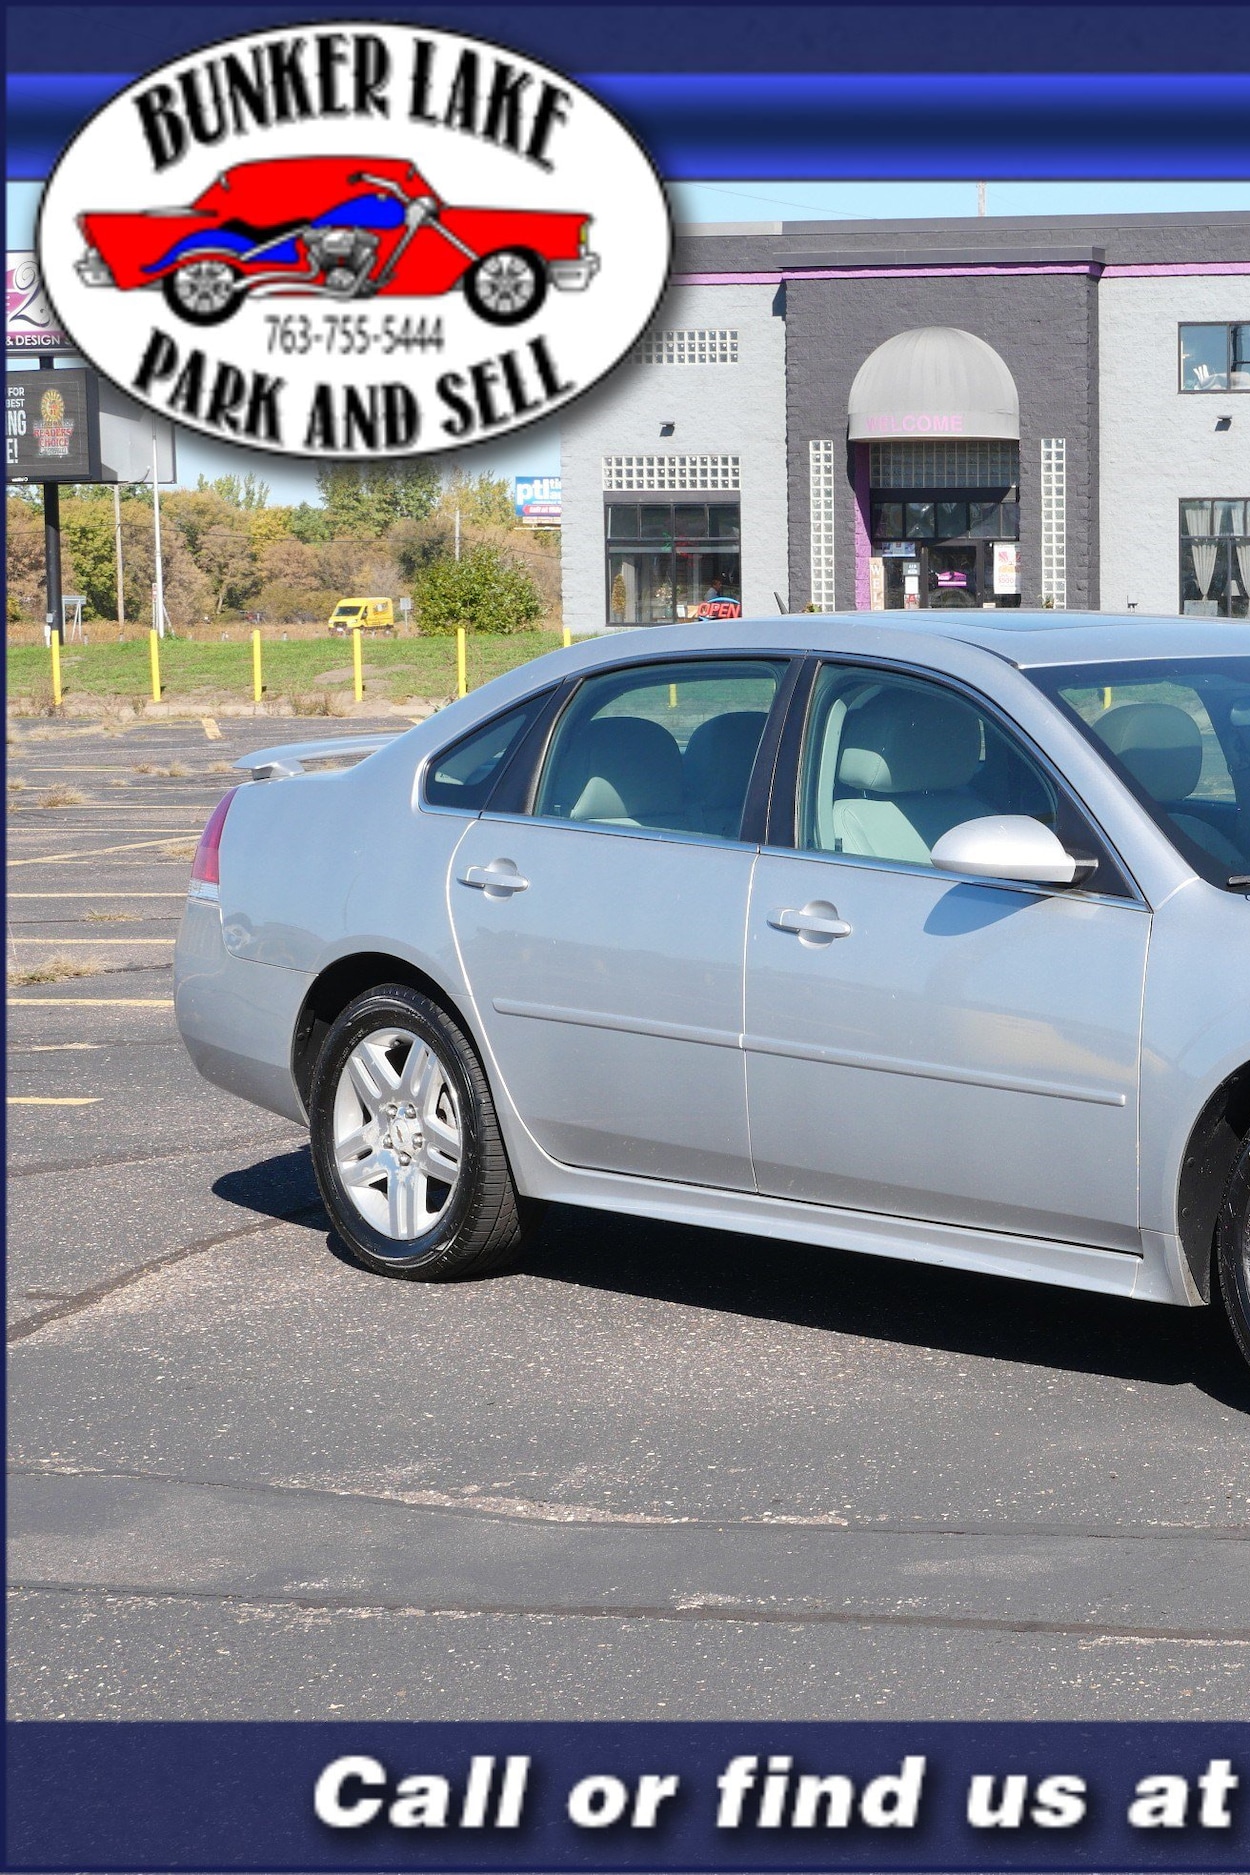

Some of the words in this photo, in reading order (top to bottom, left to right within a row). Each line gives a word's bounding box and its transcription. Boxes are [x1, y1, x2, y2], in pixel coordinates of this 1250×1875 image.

[15, 334, 61, 346] DESIGN
[8, 387, 25, 397] FOR
[865, 414, 965, 433] WELCOME
[697, 602, 741, 619] OPEN
